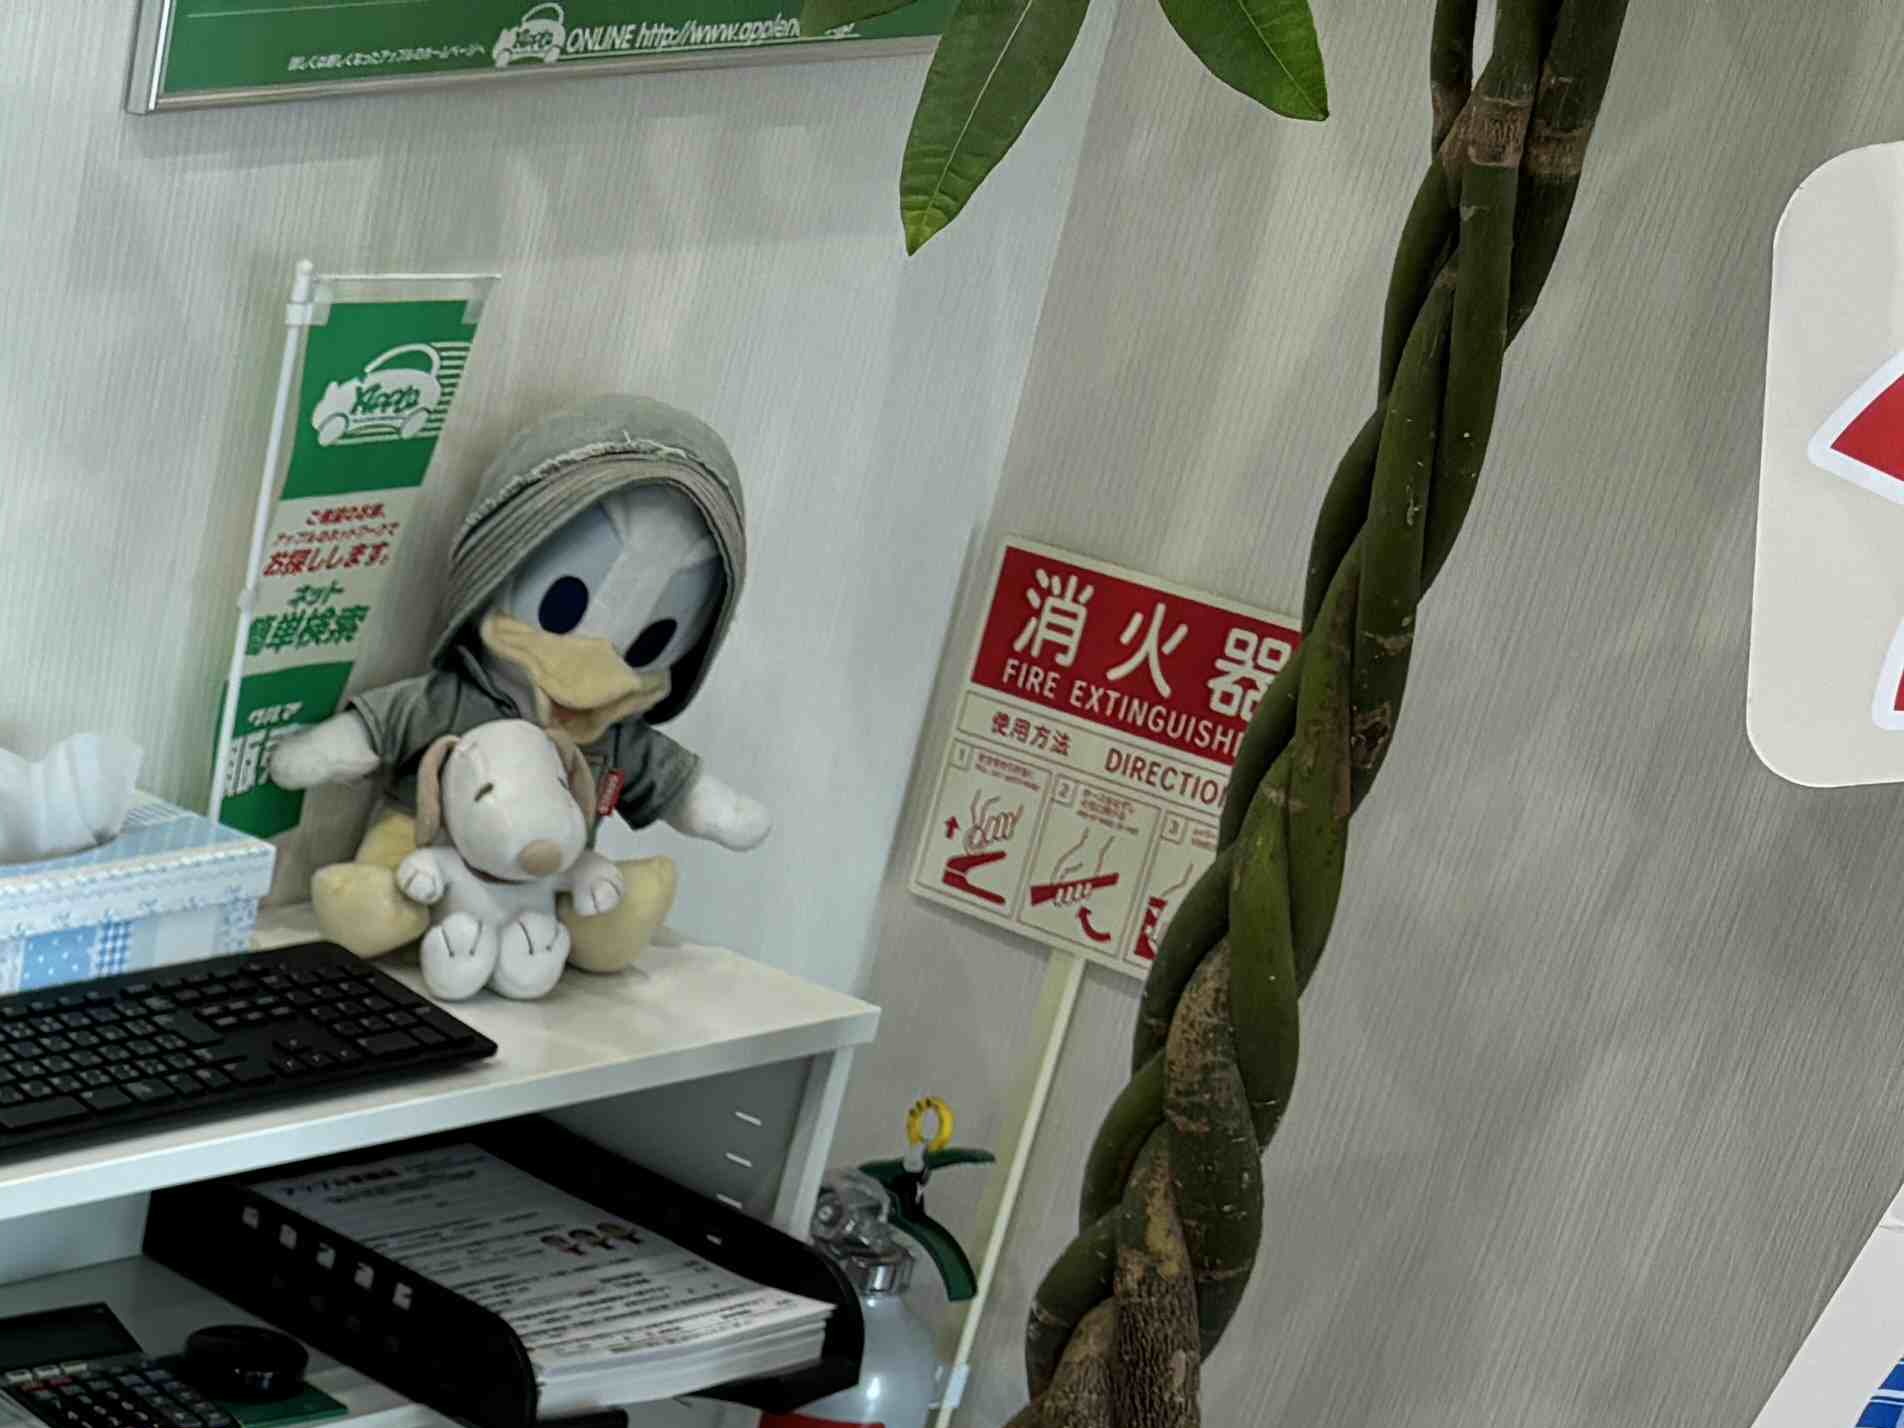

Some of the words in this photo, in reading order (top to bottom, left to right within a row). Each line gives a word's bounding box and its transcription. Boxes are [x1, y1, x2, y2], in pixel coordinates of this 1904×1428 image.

[567, 26, 633, 53] ONLINE
[245, 610, 370, 659] 簡単検索
[1014, 568, 1292, 723] 消火器
[1002, 658, 1071, 700] FIRE
[991, 711, 1072, 757] 使用方法
